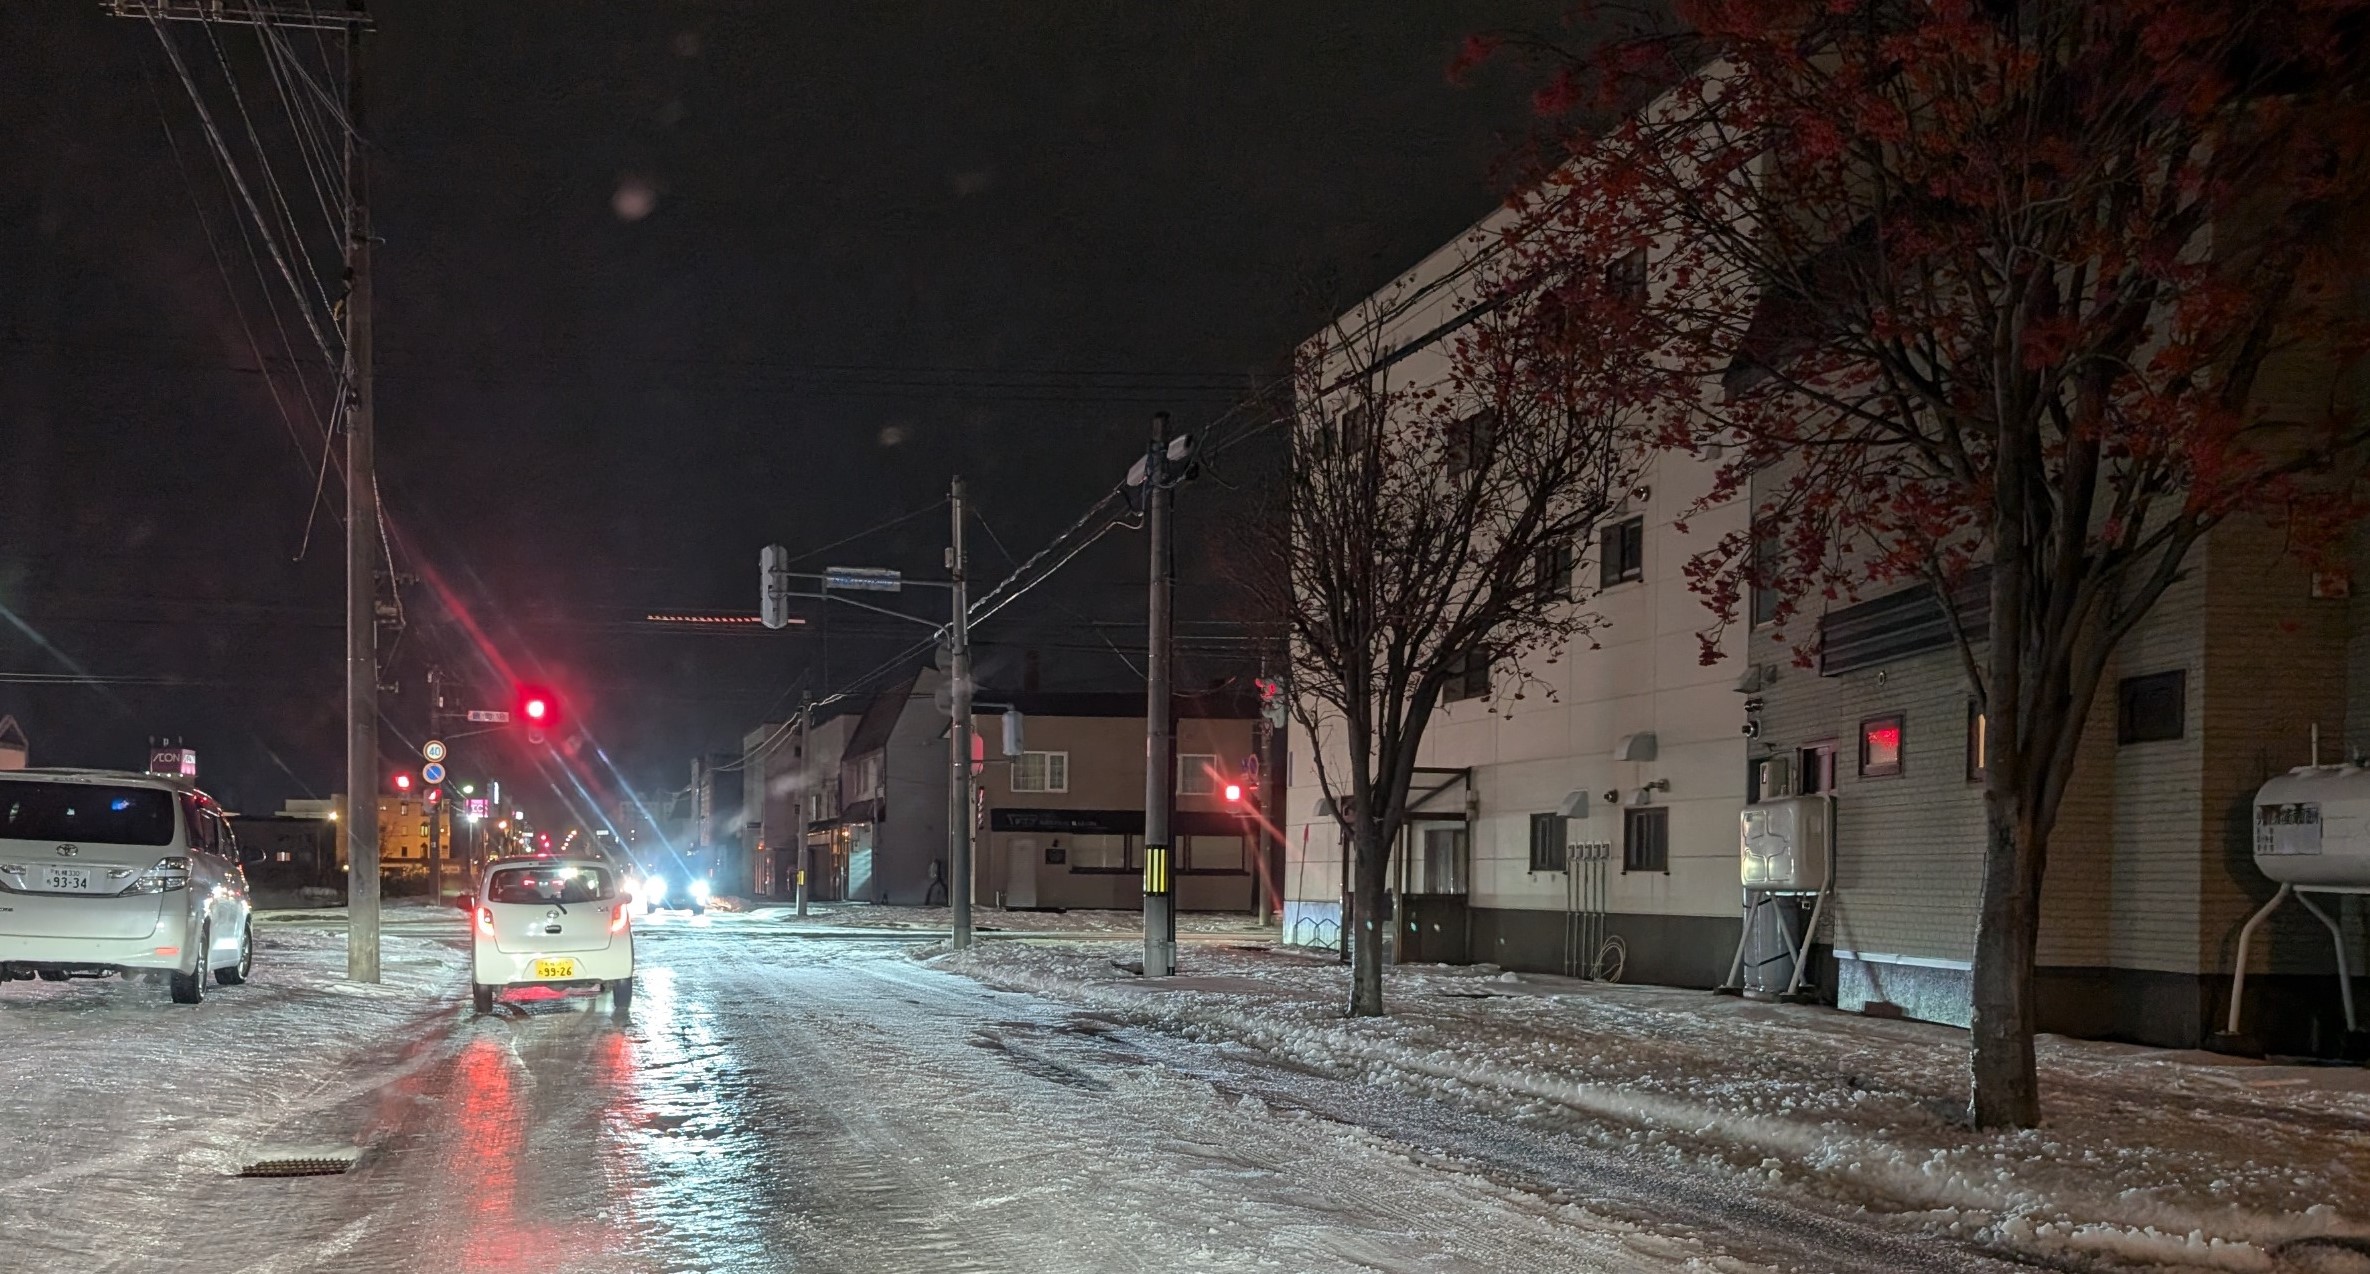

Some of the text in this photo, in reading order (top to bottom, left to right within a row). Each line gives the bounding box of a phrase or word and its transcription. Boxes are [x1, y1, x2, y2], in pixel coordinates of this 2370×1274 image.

[429, 746, 441, 756] 40
[53, 876, 87, 889] 93-34
[544, 966, 572, 977] 99-26
